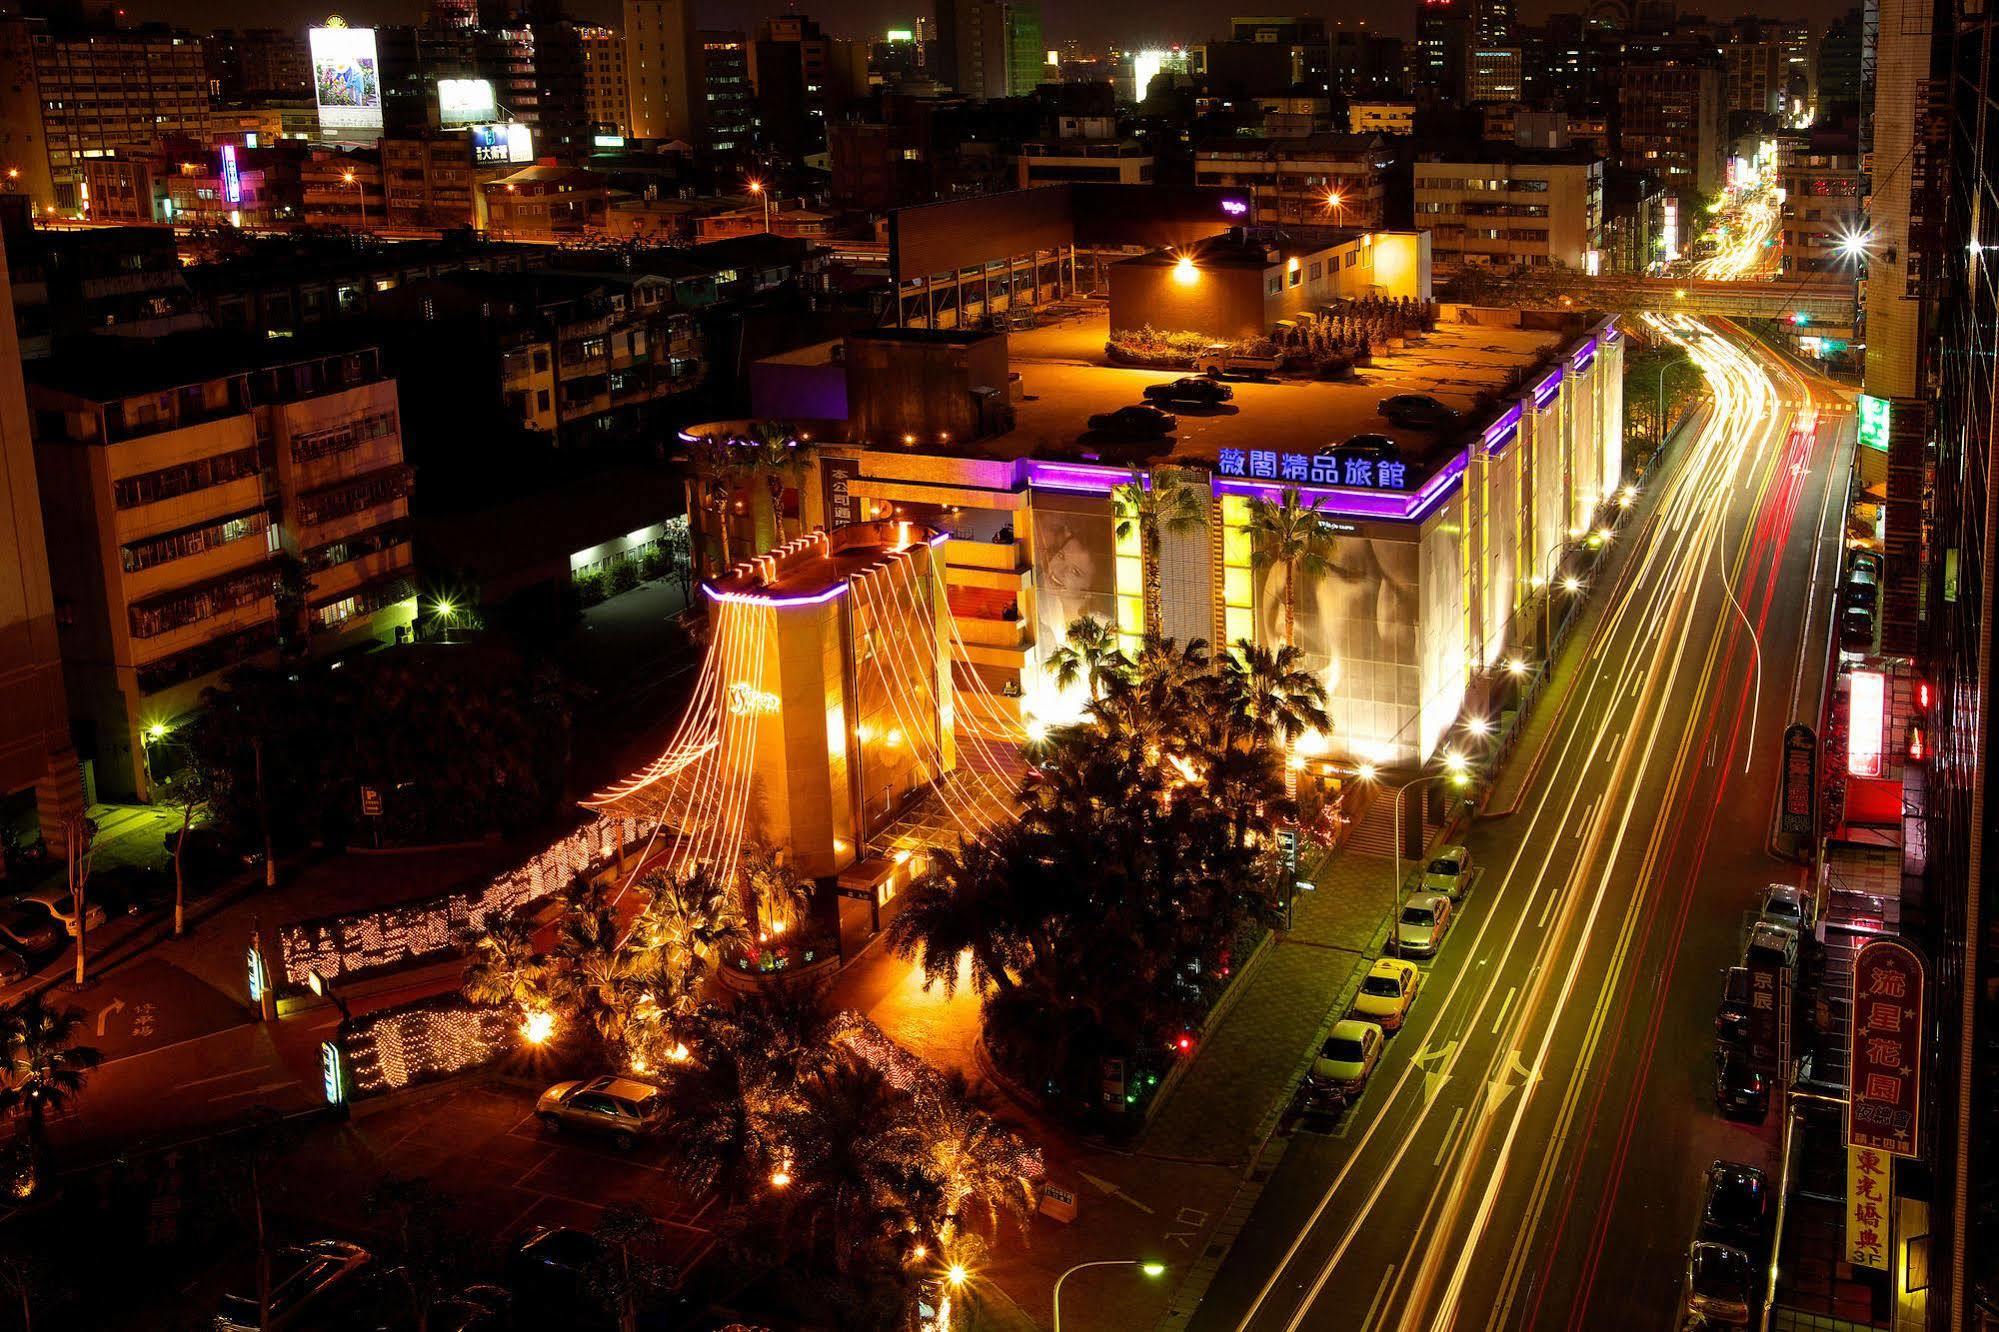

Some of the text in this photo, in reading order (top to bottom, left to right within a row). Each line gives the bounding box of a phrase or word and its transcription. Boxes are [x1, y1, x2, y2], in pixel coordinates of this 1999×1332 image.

[1218, 448, 1406, 488] 薇閣精品旅館
[1866, 966, 1906, 1105] 流星花園
[1852, 1250, 1882, 1265] 3F
